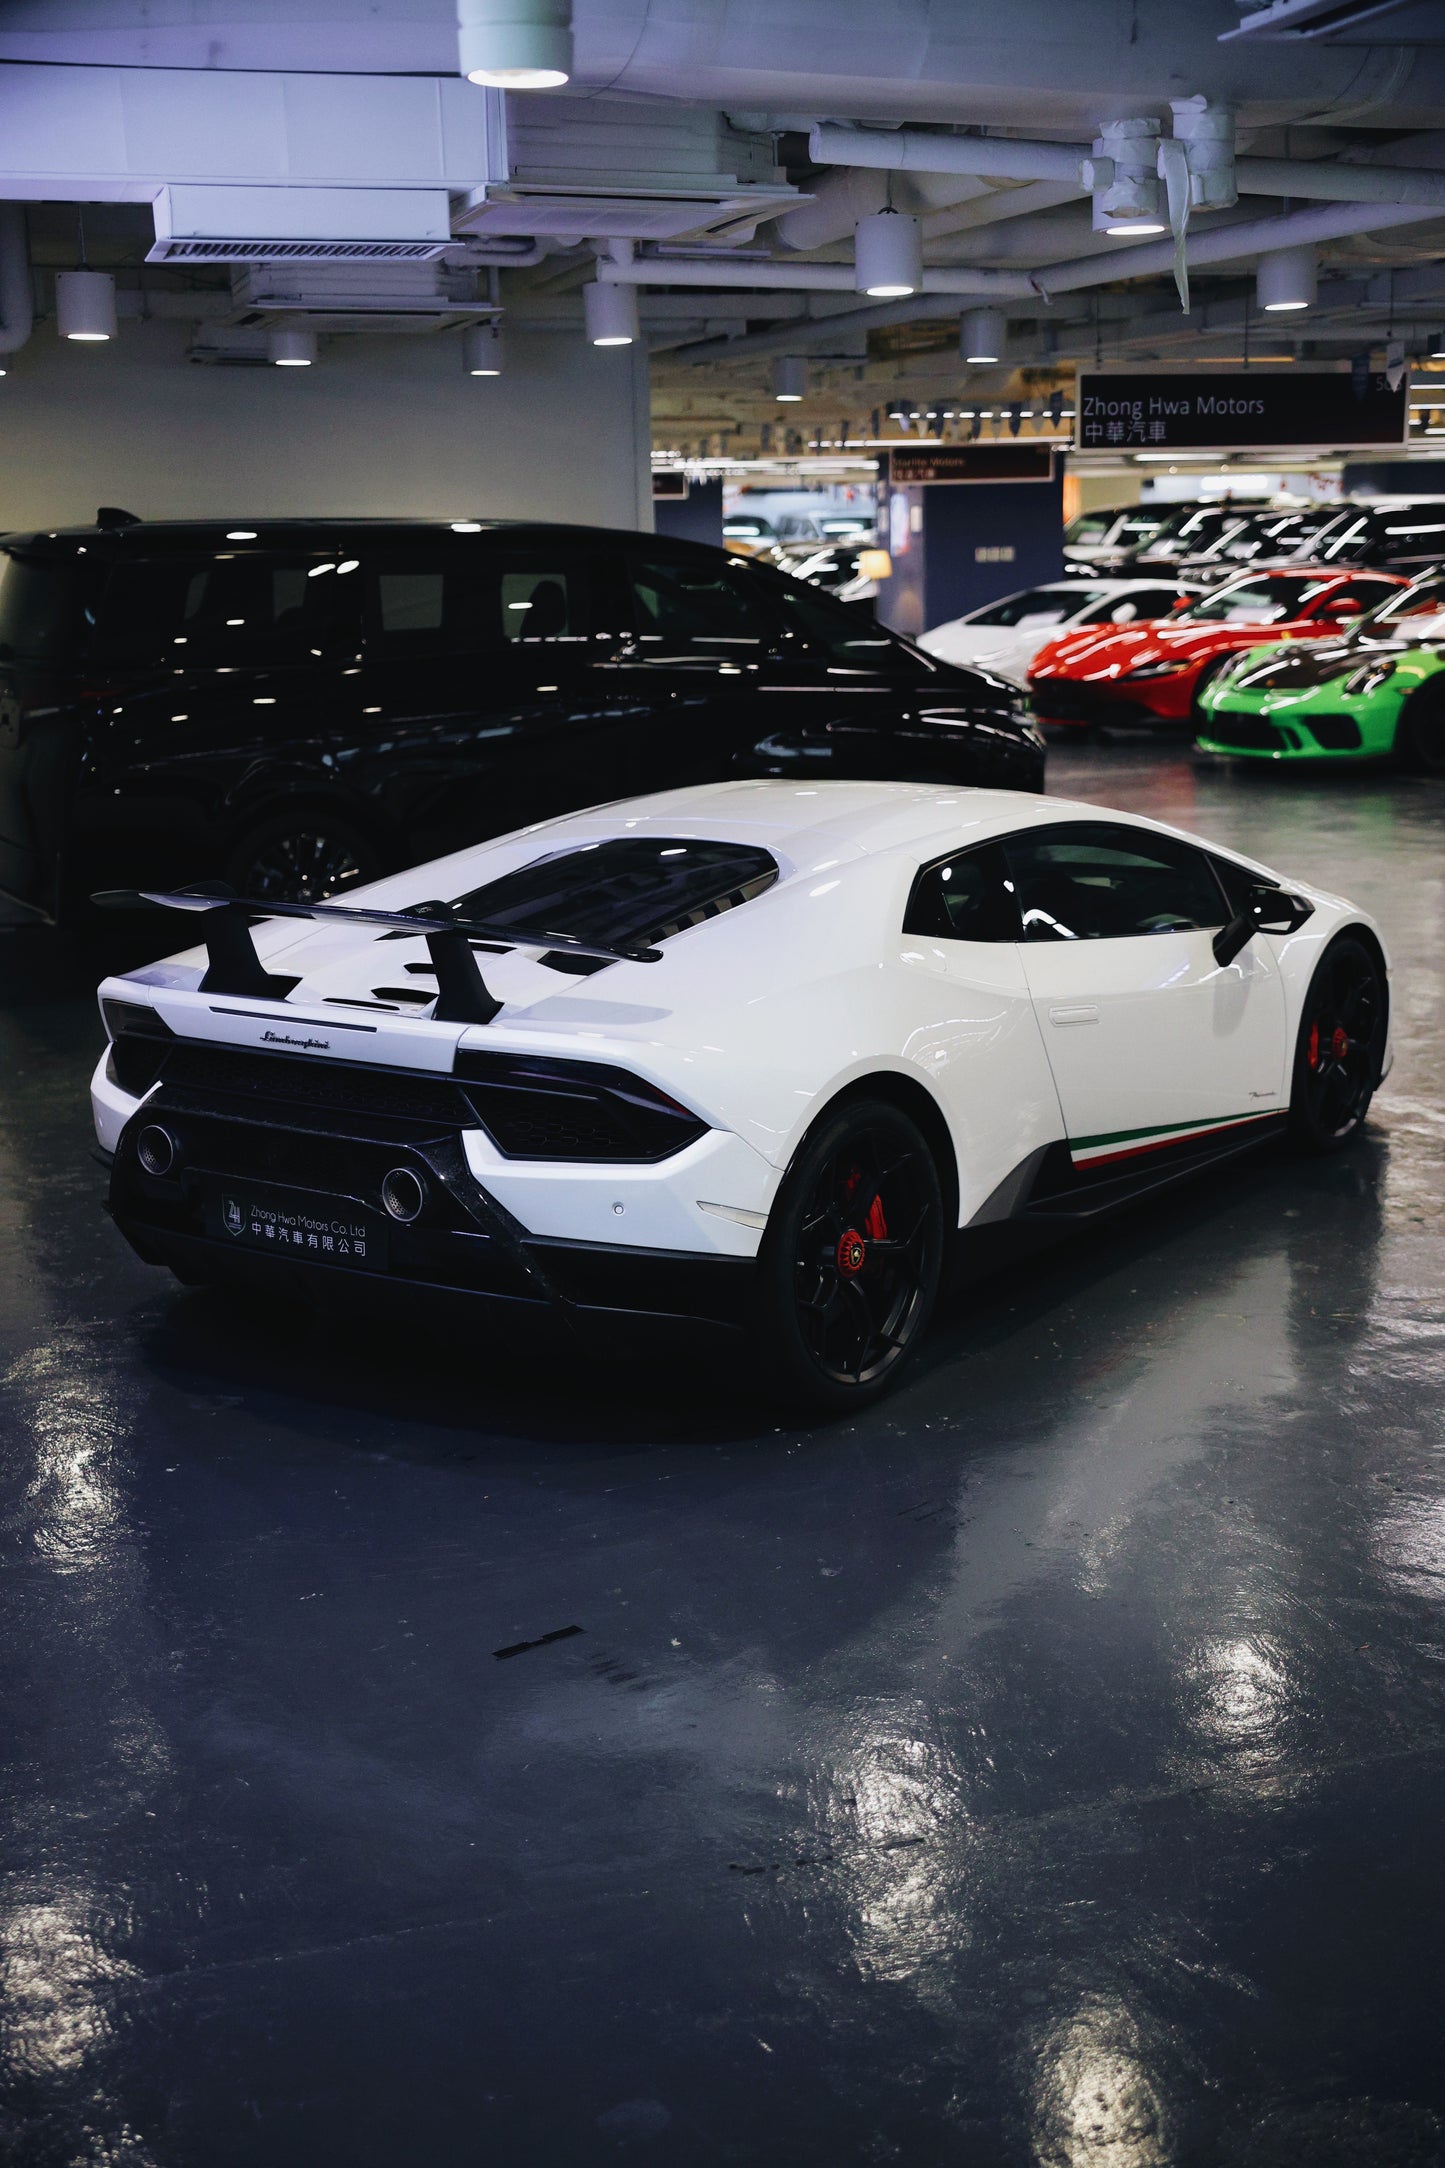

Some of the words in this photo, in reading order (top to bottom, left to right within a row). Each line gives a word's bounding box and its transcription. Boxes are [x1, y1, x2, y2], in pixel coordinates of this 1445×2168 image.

[1083, 396, 1143, 420] Zhong
[1149, 396, 1190, 415] Hwa
[1196, 396, 1265, 415] Motors
[1085, 420, 1167, 443] 中華汽車
[250, 1205, 277, 1223] Zhong
[277, 1211, 296, 1226] Hwa
[297, 1215, 329, 1232] Motors
[330, 1221, 348, 1235] Co.
[350, 1224, 366, 1238] Ltd
[251, 1221, 366, 1257] 中華汽車有限公司
